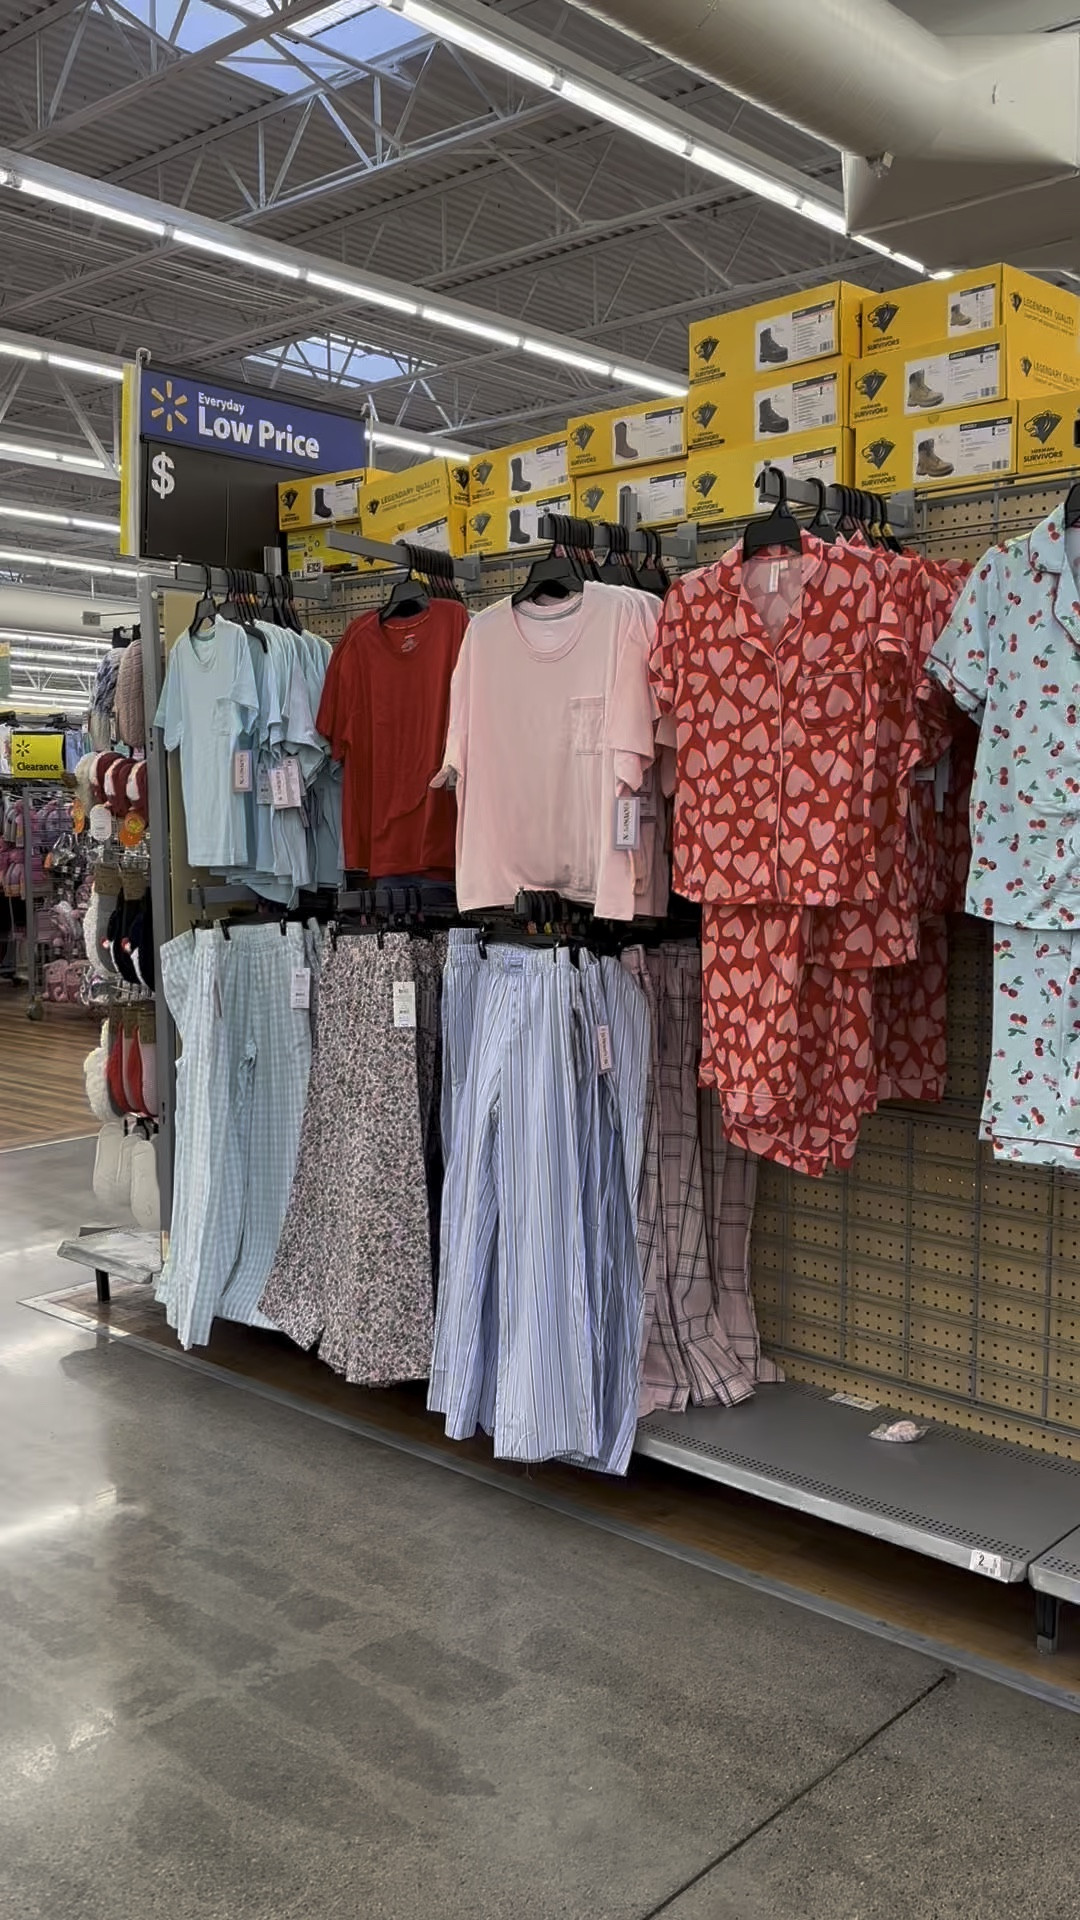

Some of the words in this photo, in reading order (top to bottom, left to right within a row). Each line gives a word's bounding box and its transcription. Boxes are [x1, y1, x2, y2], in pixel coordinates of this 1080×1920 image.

[198, 392, 245, 415] Everyday
[198, 406, 253, 444] Low
[258, 419, 320, 459] Price
[1024, 451, 1063, 462] SURVIVORS
[151, 452, 176, 499] $
[17, 761, 59, 772] Clearance
